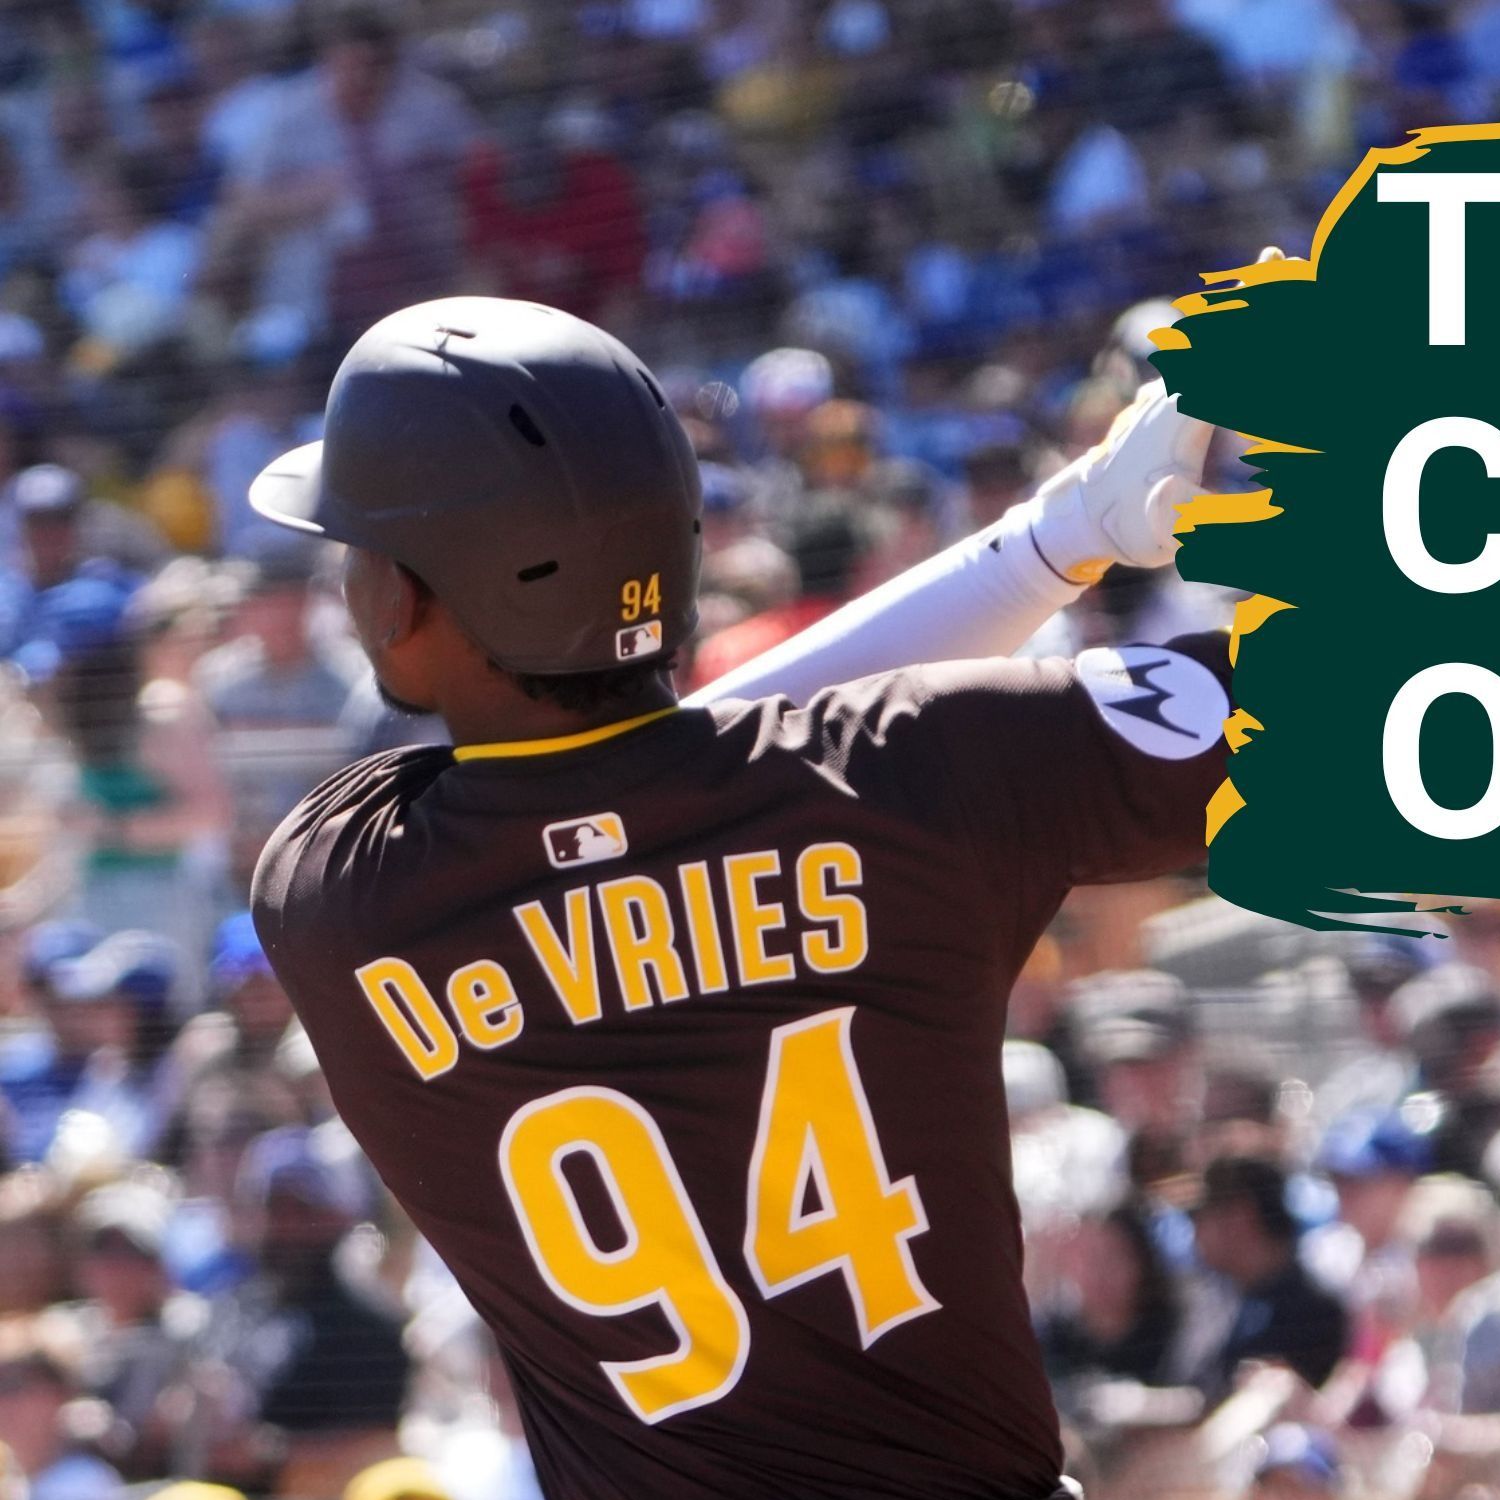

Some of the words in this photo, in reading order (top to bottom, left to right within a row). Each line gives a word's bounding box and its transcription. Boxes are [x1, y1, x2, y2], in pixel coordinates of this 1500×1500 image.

[622, 572, 661, 621] 94
[355, 957, 524, 1081] De
[512, 842, 869, 1025] VRIES
[498, 1006, 943, 1425] 94
